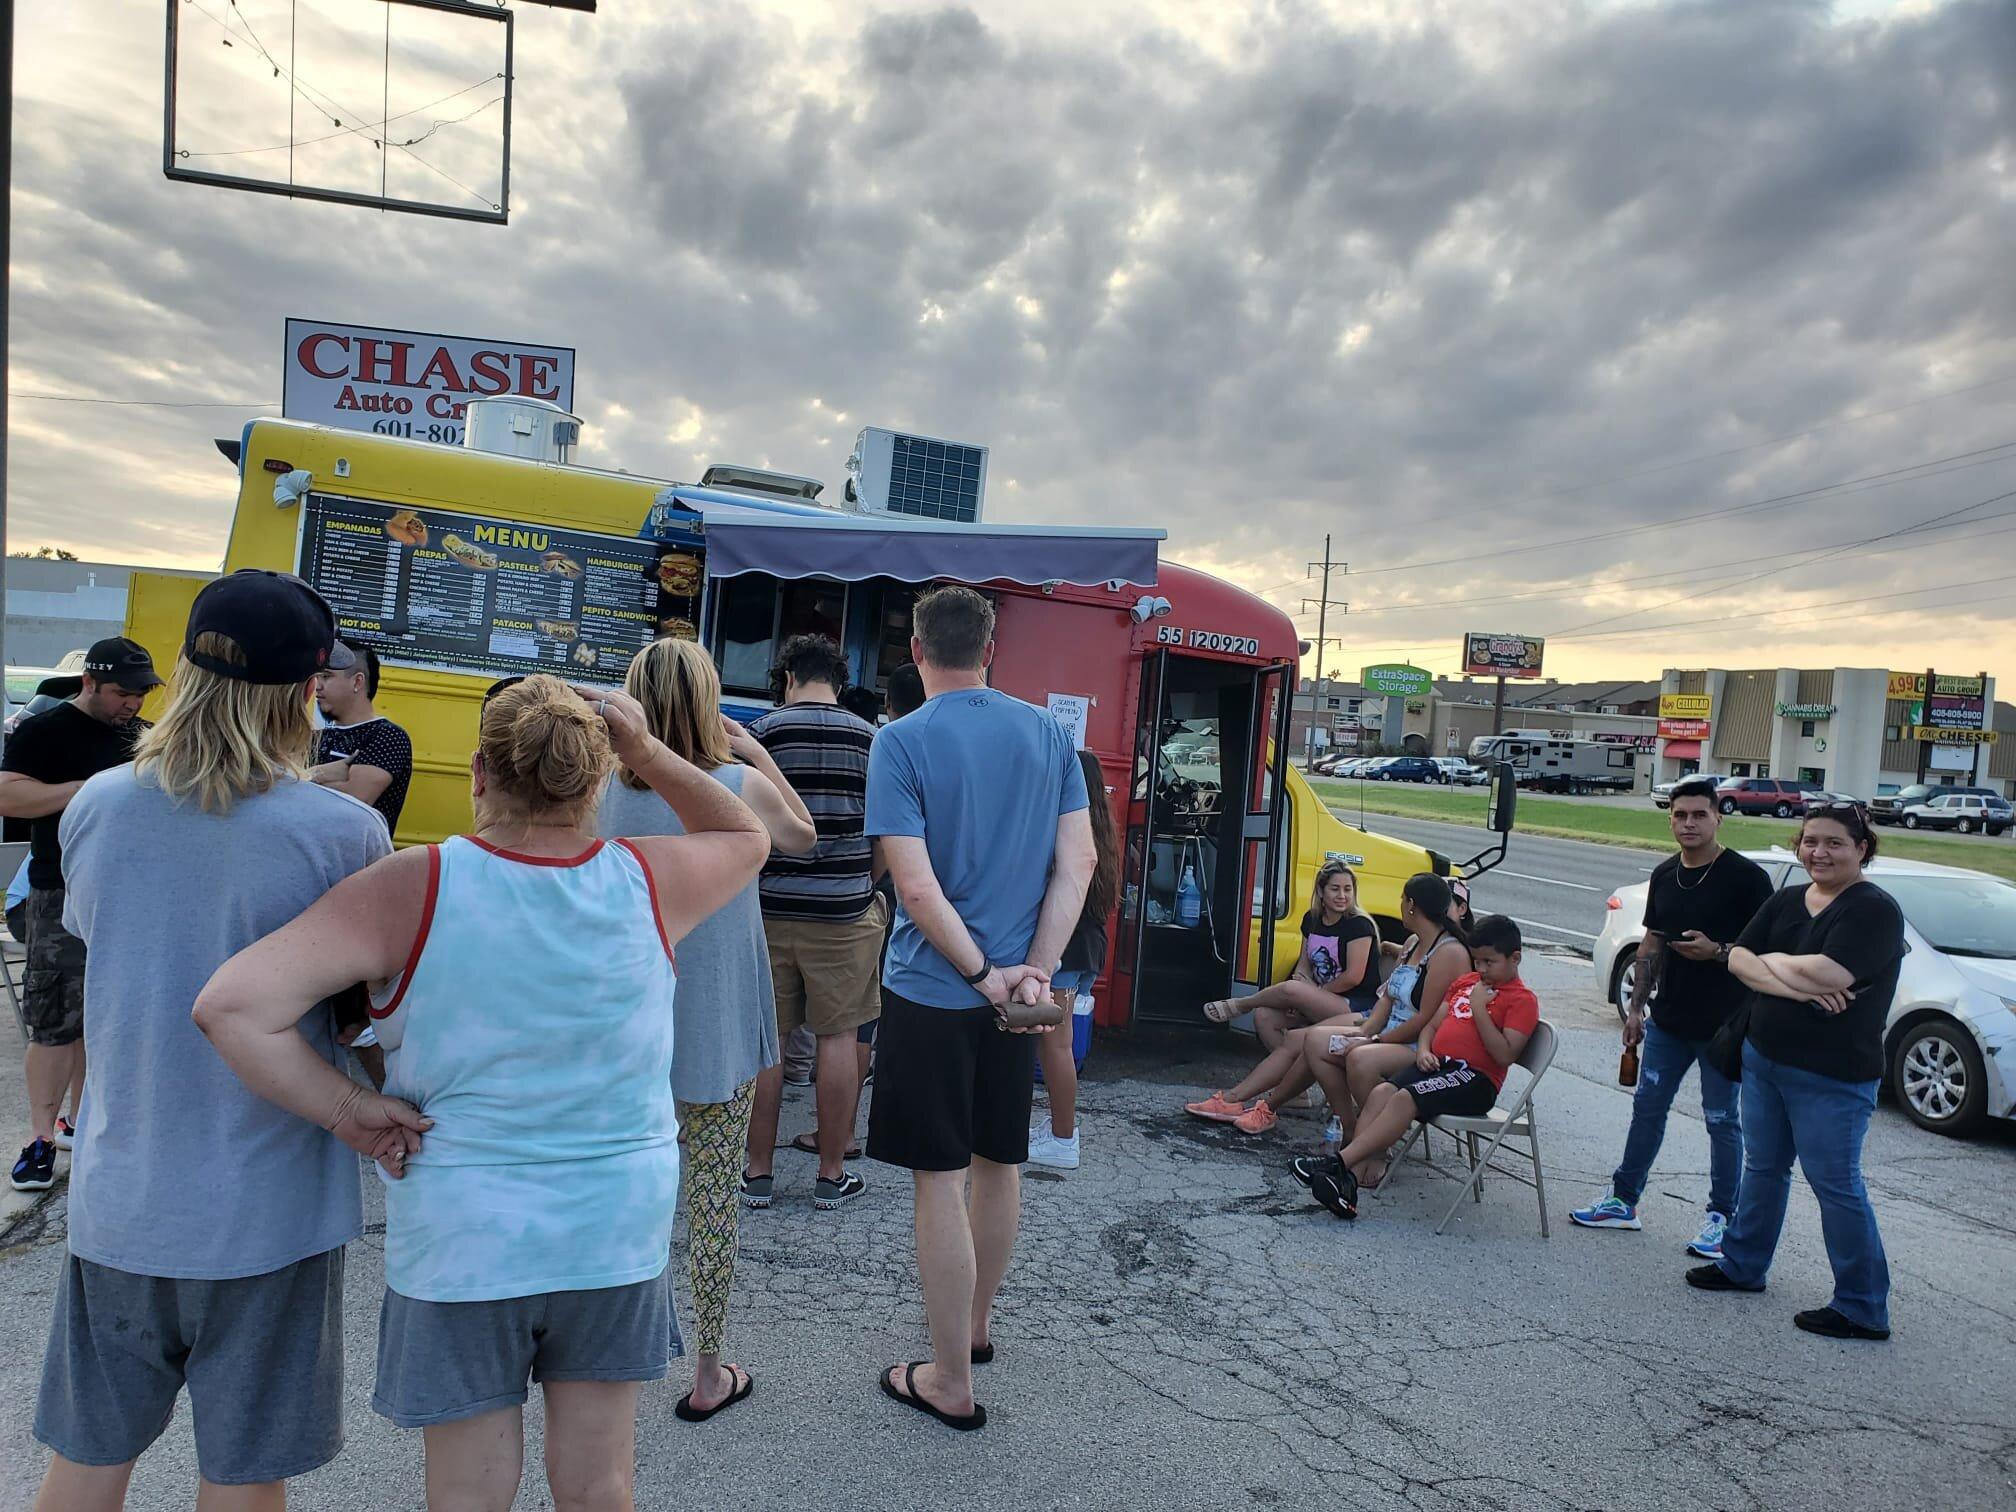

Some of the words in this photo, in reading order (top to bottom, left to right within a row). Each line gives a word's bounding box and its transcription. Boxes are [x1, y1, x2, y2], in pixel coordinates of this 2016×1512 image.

[297, 333, 561, 401] CHASE
[334, 385, 414, 415] Auto
[326, 520, 382, 535] EMPANADAS
[473, 525, 549, 551] MENU
[413, 550, 447, 560] AREPAS
[499, 561, 539, 572] PASTELES
[587, 557, 644, 571] HAMBURGERS
[582, 606, 611, 616] PEPITO
[613, 610, 658, 622] SANDWICH
[340, 618, 358, 627] HOT
[360, 621, 380, 630] DOG
[493, 619, 532, 629] PATACON
[1159, 627, 1182, 644] 55
[1191, 630, 1257, 654] 120920
[1372, 669, 1425, 682] ExtraSpace
[1889, 675, 1914, 695] 4.99
[1937, 684, 1955, 692] AUTO
[1957, 685, 1979, 694] GROUP
[1939, 730, 1991, 742] CHEESE
